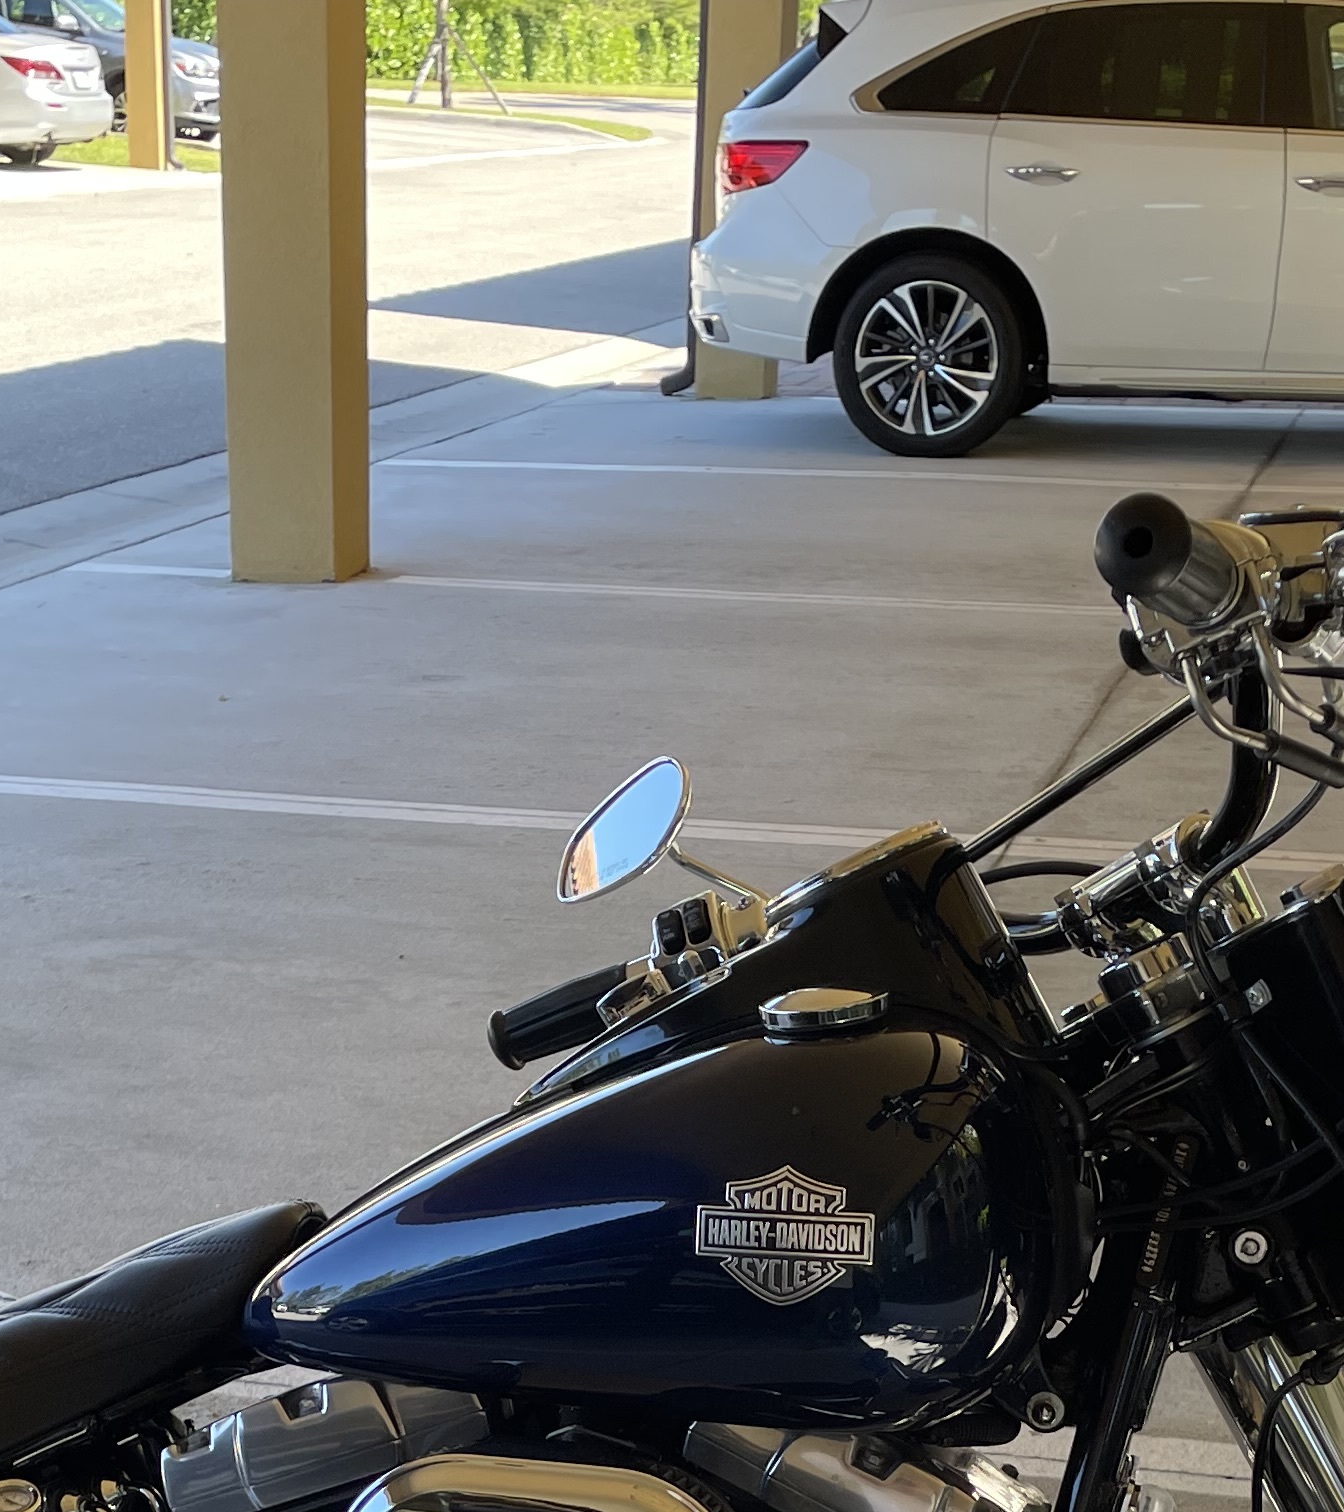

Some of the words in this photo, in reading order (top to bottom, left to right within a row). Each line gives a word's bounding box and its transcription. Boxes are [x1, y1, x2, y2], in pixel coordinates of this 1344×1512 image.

[744, 1180, 826, 1214] MOTOR
[708, 1217, 861, 1252] HARLEY-DAVIDSON
[742, 1257, 822, 1293] CYCLES
